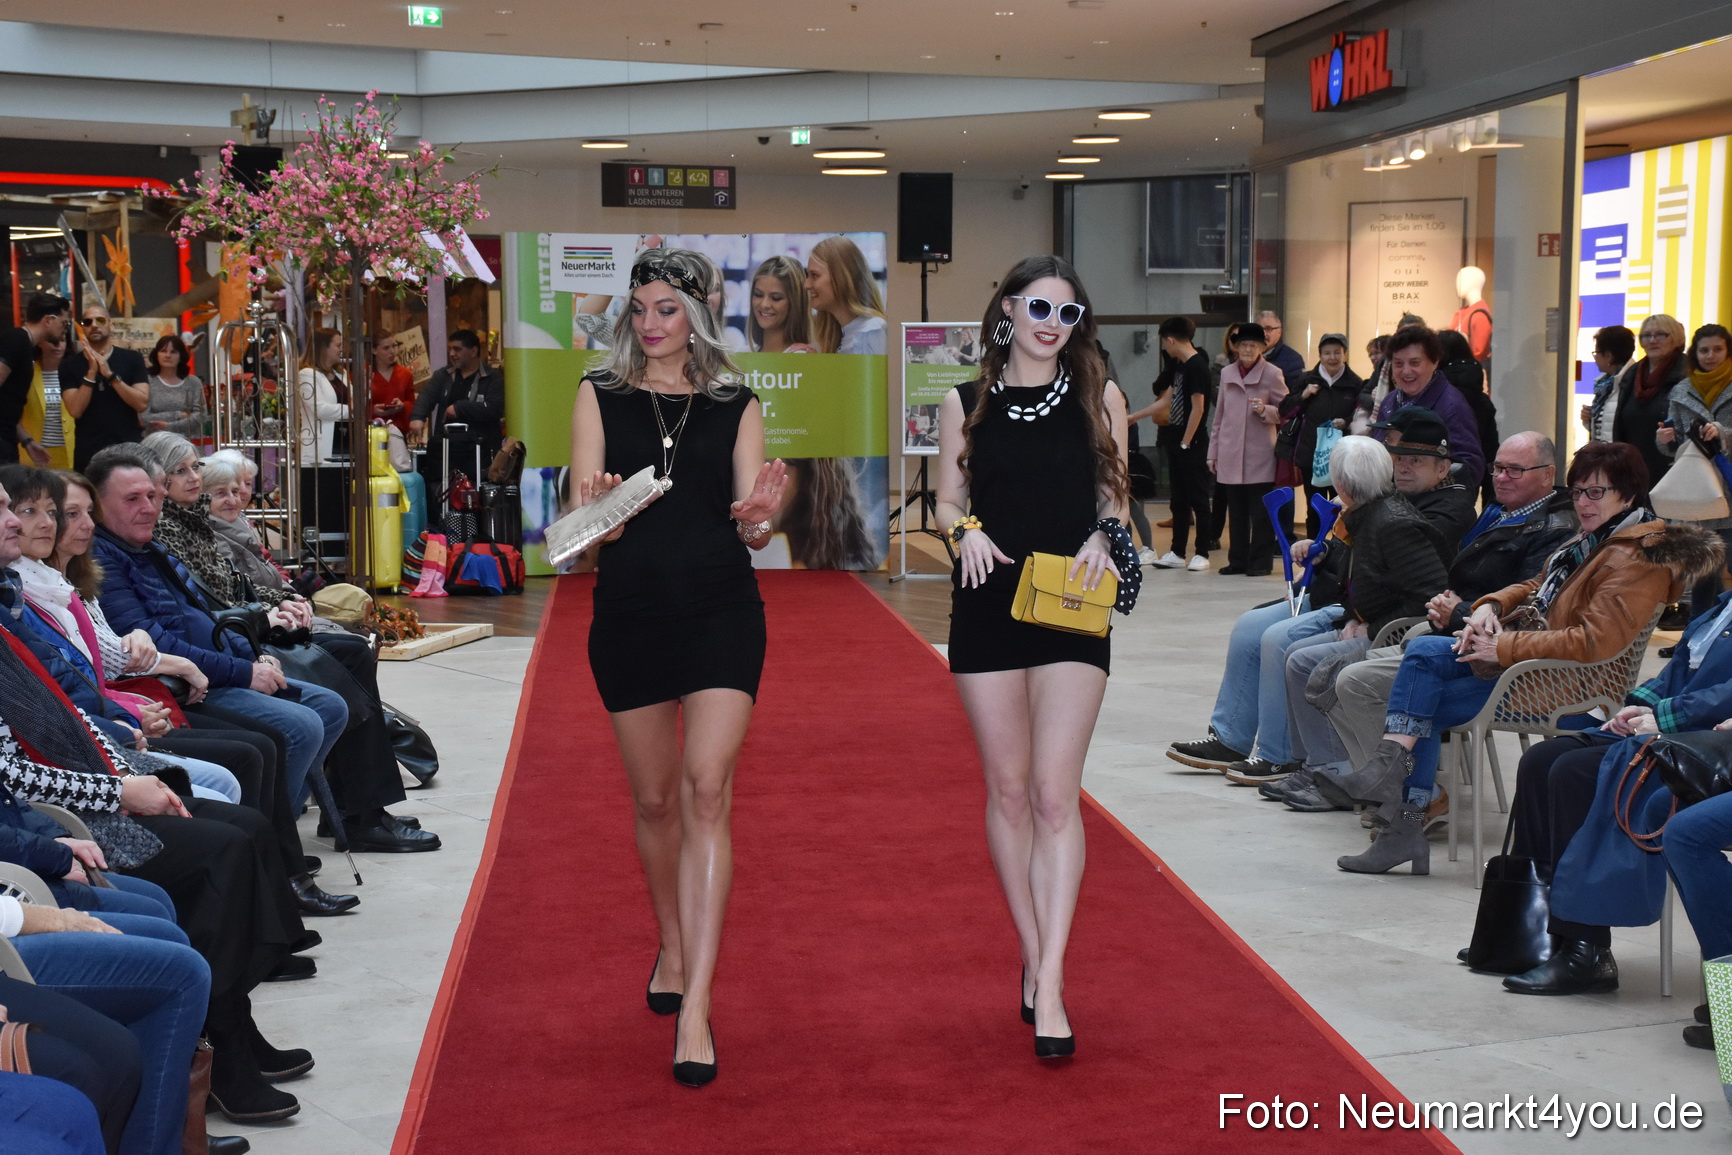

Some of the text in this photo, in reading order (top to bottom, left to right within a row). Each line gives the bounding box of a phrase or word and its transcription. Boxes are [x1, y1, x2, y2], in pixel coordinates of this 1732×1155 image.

[1309, 28, 1393, 113] WÖHRL
[628, 188, 636, 196] IN
[637, 188, 650, 196] DER
[628, 198, 684, 207] LADENSTRASSE
[1405, 212, 1436, 220] Marken
[1369, 223, 1395, 232] finden
[1397, 222, 1410, 231] Sie
[1412, 222, 1423, 230] im
[1386, 240, 1399, 248] Für
[561, 261, 616, 271] NeuerMarkt
[1392, 292, 1420, 300] BRAX
[763, 427, 809, 435] Gastronomie.
[771, 436, 792, 444] dabei.
